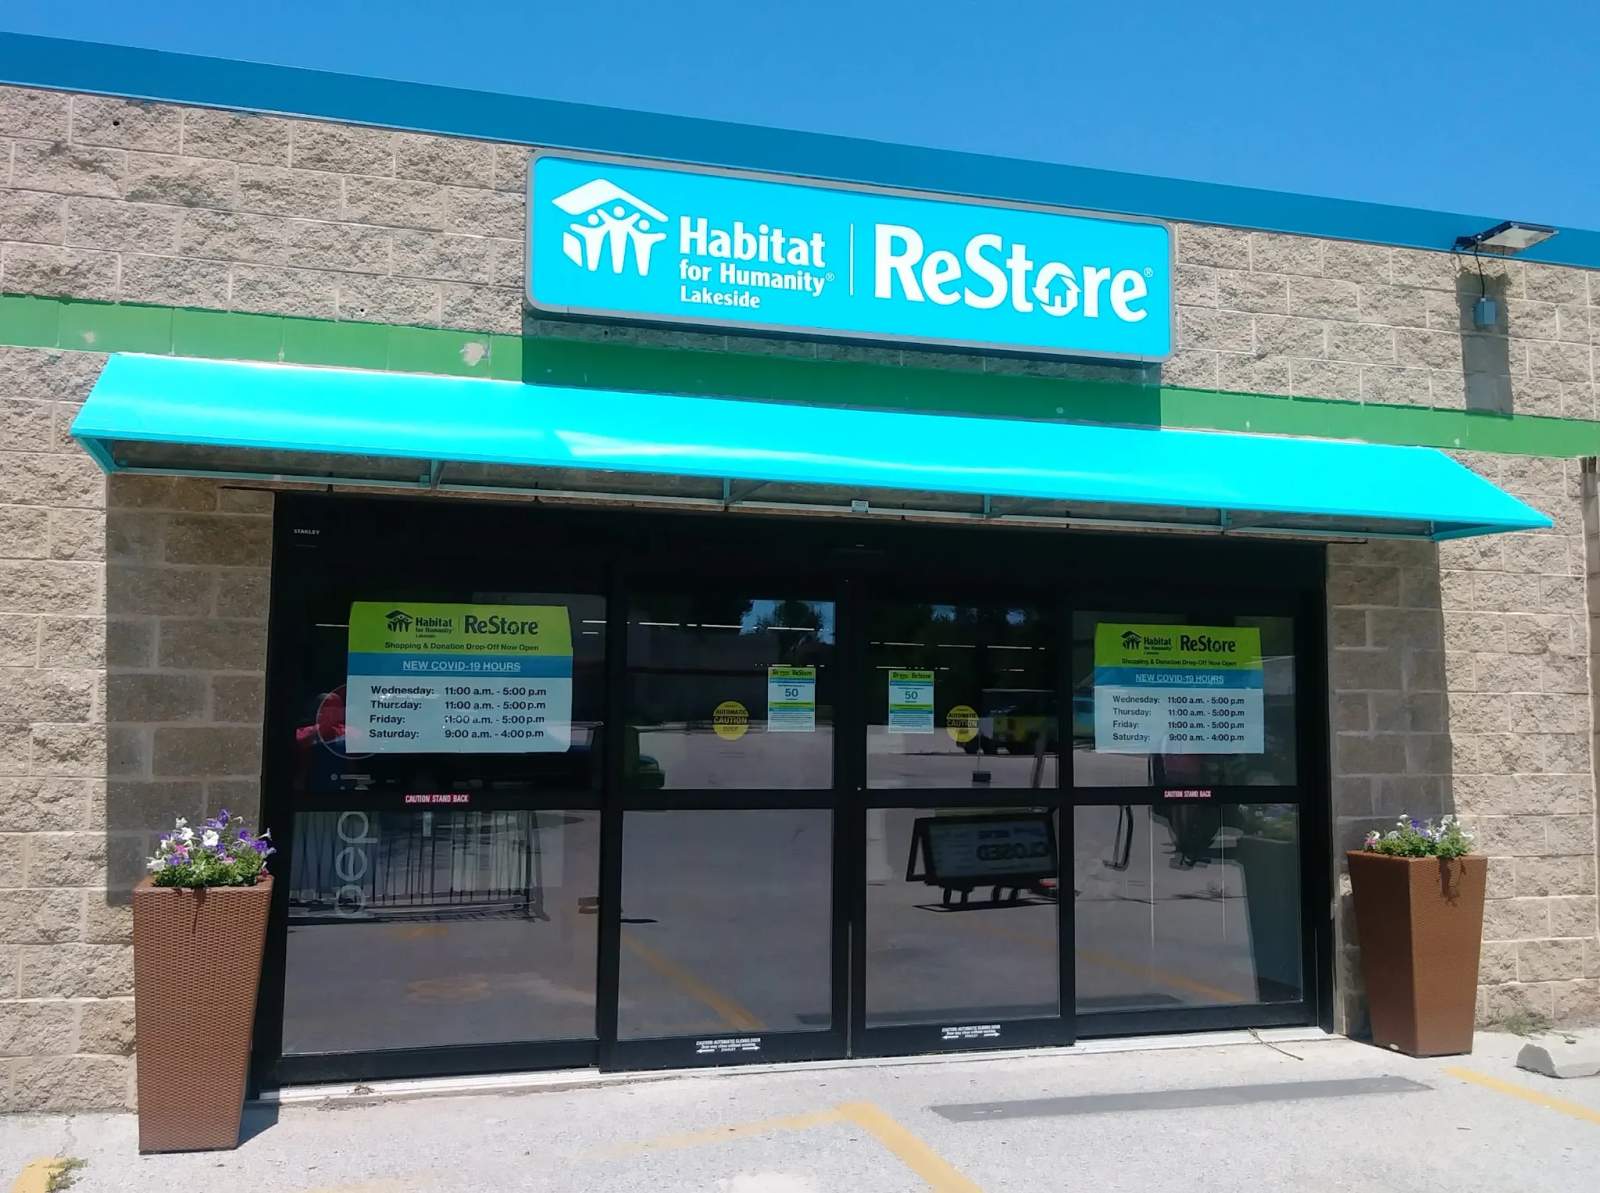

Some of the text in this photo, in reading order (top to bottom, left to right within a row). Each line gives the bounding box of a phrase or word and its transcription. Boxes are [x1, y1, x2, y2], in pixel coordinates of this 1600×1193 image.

[679, 215, 826, 268] Habitat
[679, 258, 712, 281] for
[680, 285, 760, 309] Lakeside
[415, 616, 453, 628] Habitat
[464, 614, 539, 635] ReStore
[384, 641, 422, 650] Shopping
[430, 642, 465, 650] Donation
[466, 642, 500, 651] Drop-Off
[519, 643, 539, 652] Open
[1143, 636, 1172, 646] Habitat
[1180, 634, 1236, 653] ReStore
[402, 660, 521, 673] NEW COVID-19 HOURS
[1135, 673, 1155, 682] NEW
[1195, 675, 1224, 684] HOURS
[370, 685, 435, 696] Wednesday:
[445, 686, 471, 695] 11:00
[502, 687, 526, 696] 5:00
[784, 687, 800, 698] 50
[904, 690, 919, 701] 50
[370, 700, 422, 710] Thursday:
[445, 701, 471, 710] 11:00
[473, 702, 494, 710] a.m.
[502, 701, 527, 710] 5:00
[1112, 696, 1160, 704] Wednesday:
[1112, 708, 1151, 717] Thursday:
[369, 714, 406, 725] Friday:
[502, 715, 526, 724] 5:00
[713, 716, 748, 724] CAUTION
[368, 729, 420, 739] Saturday:
[445, 729, 469, 738] 9:00
[500, 729, 524, 738] 4:00
[1112, 733, 1150, 742] Saturday:
[405, 795, 430, 803] CAUTION
